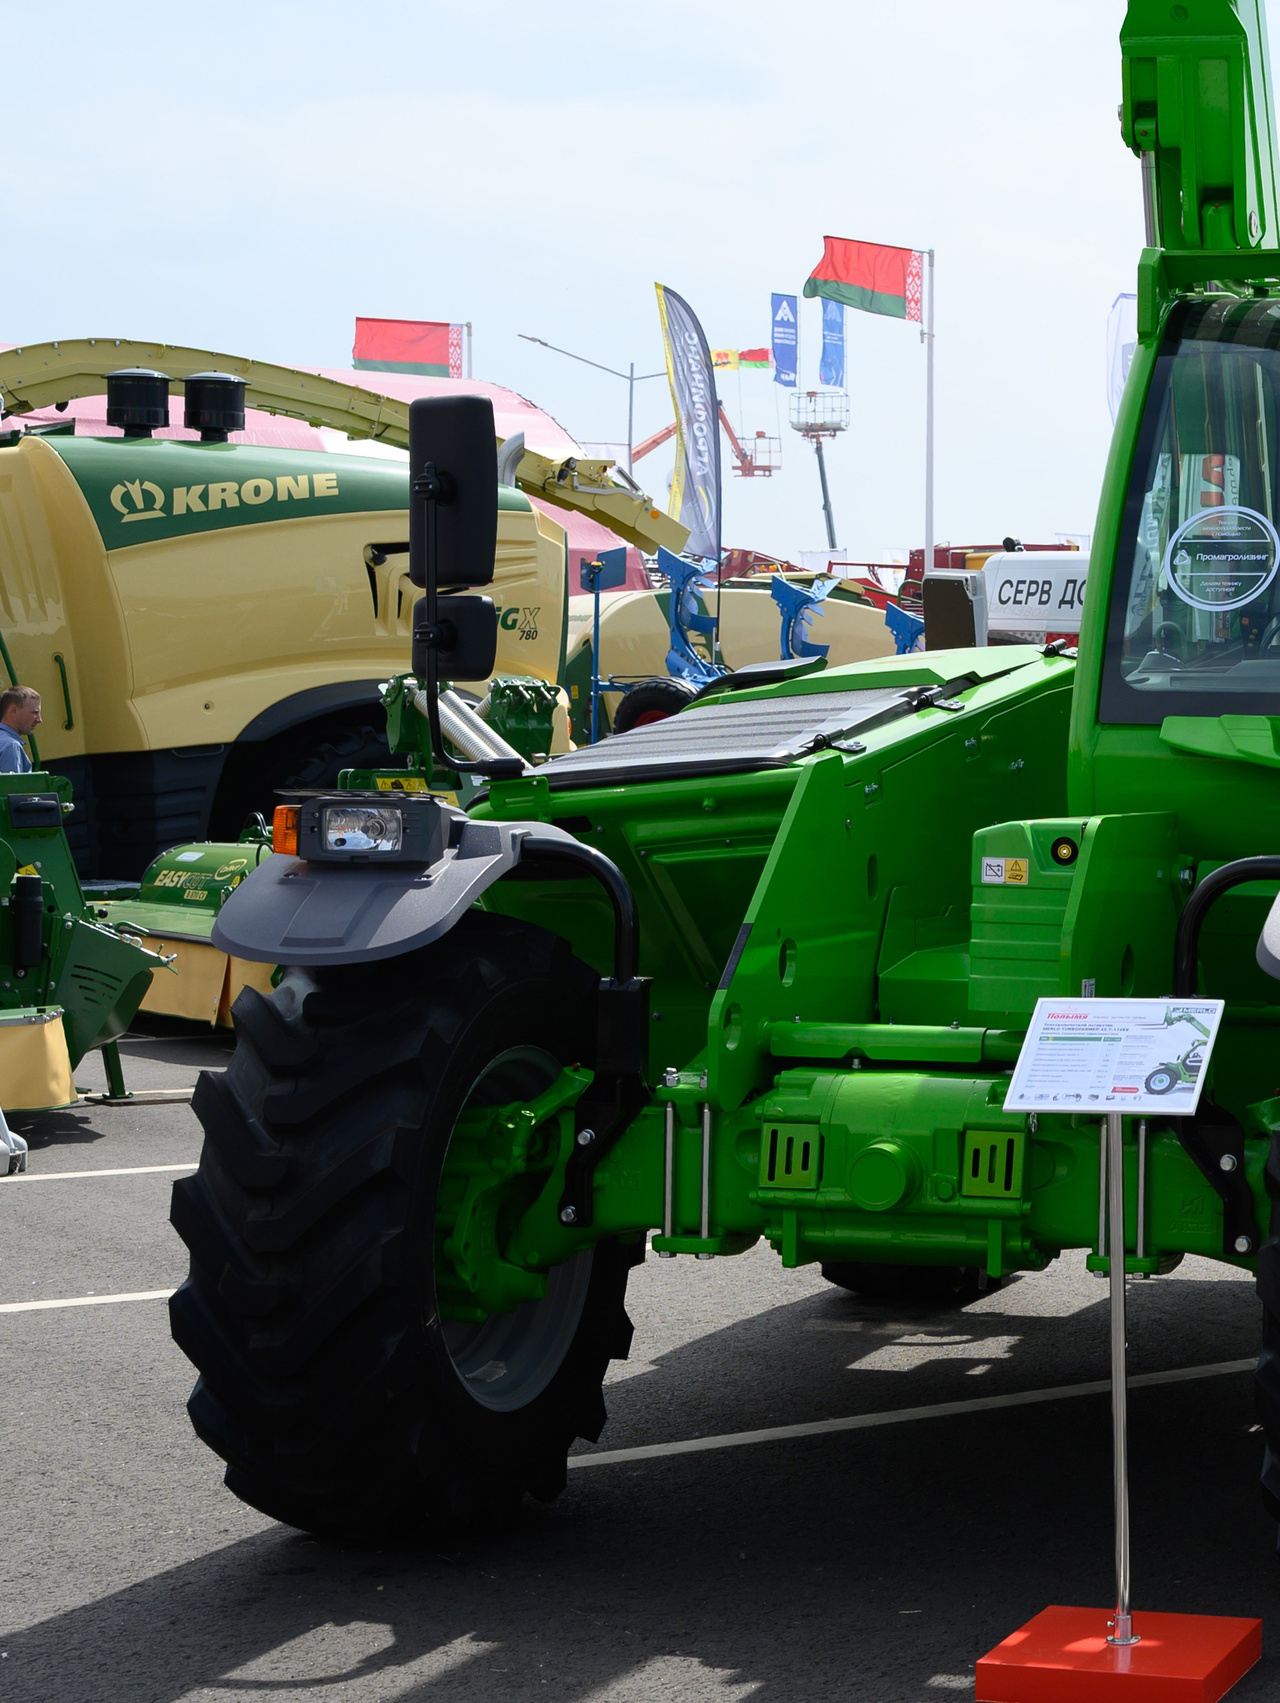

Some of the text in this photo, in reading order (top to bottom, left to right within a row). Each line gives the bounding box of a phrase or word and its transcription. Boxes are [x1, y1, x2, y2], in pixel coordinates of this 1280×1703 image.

[173, 472, 340, 516] KRONE
[1196, 553, 1269, 562] Промагролизинг
[998, 579, 1052, 605] СЕРВ
[519, 630, 538, 641] 780
[1046, 1012, 1089, 1020] Полымя
